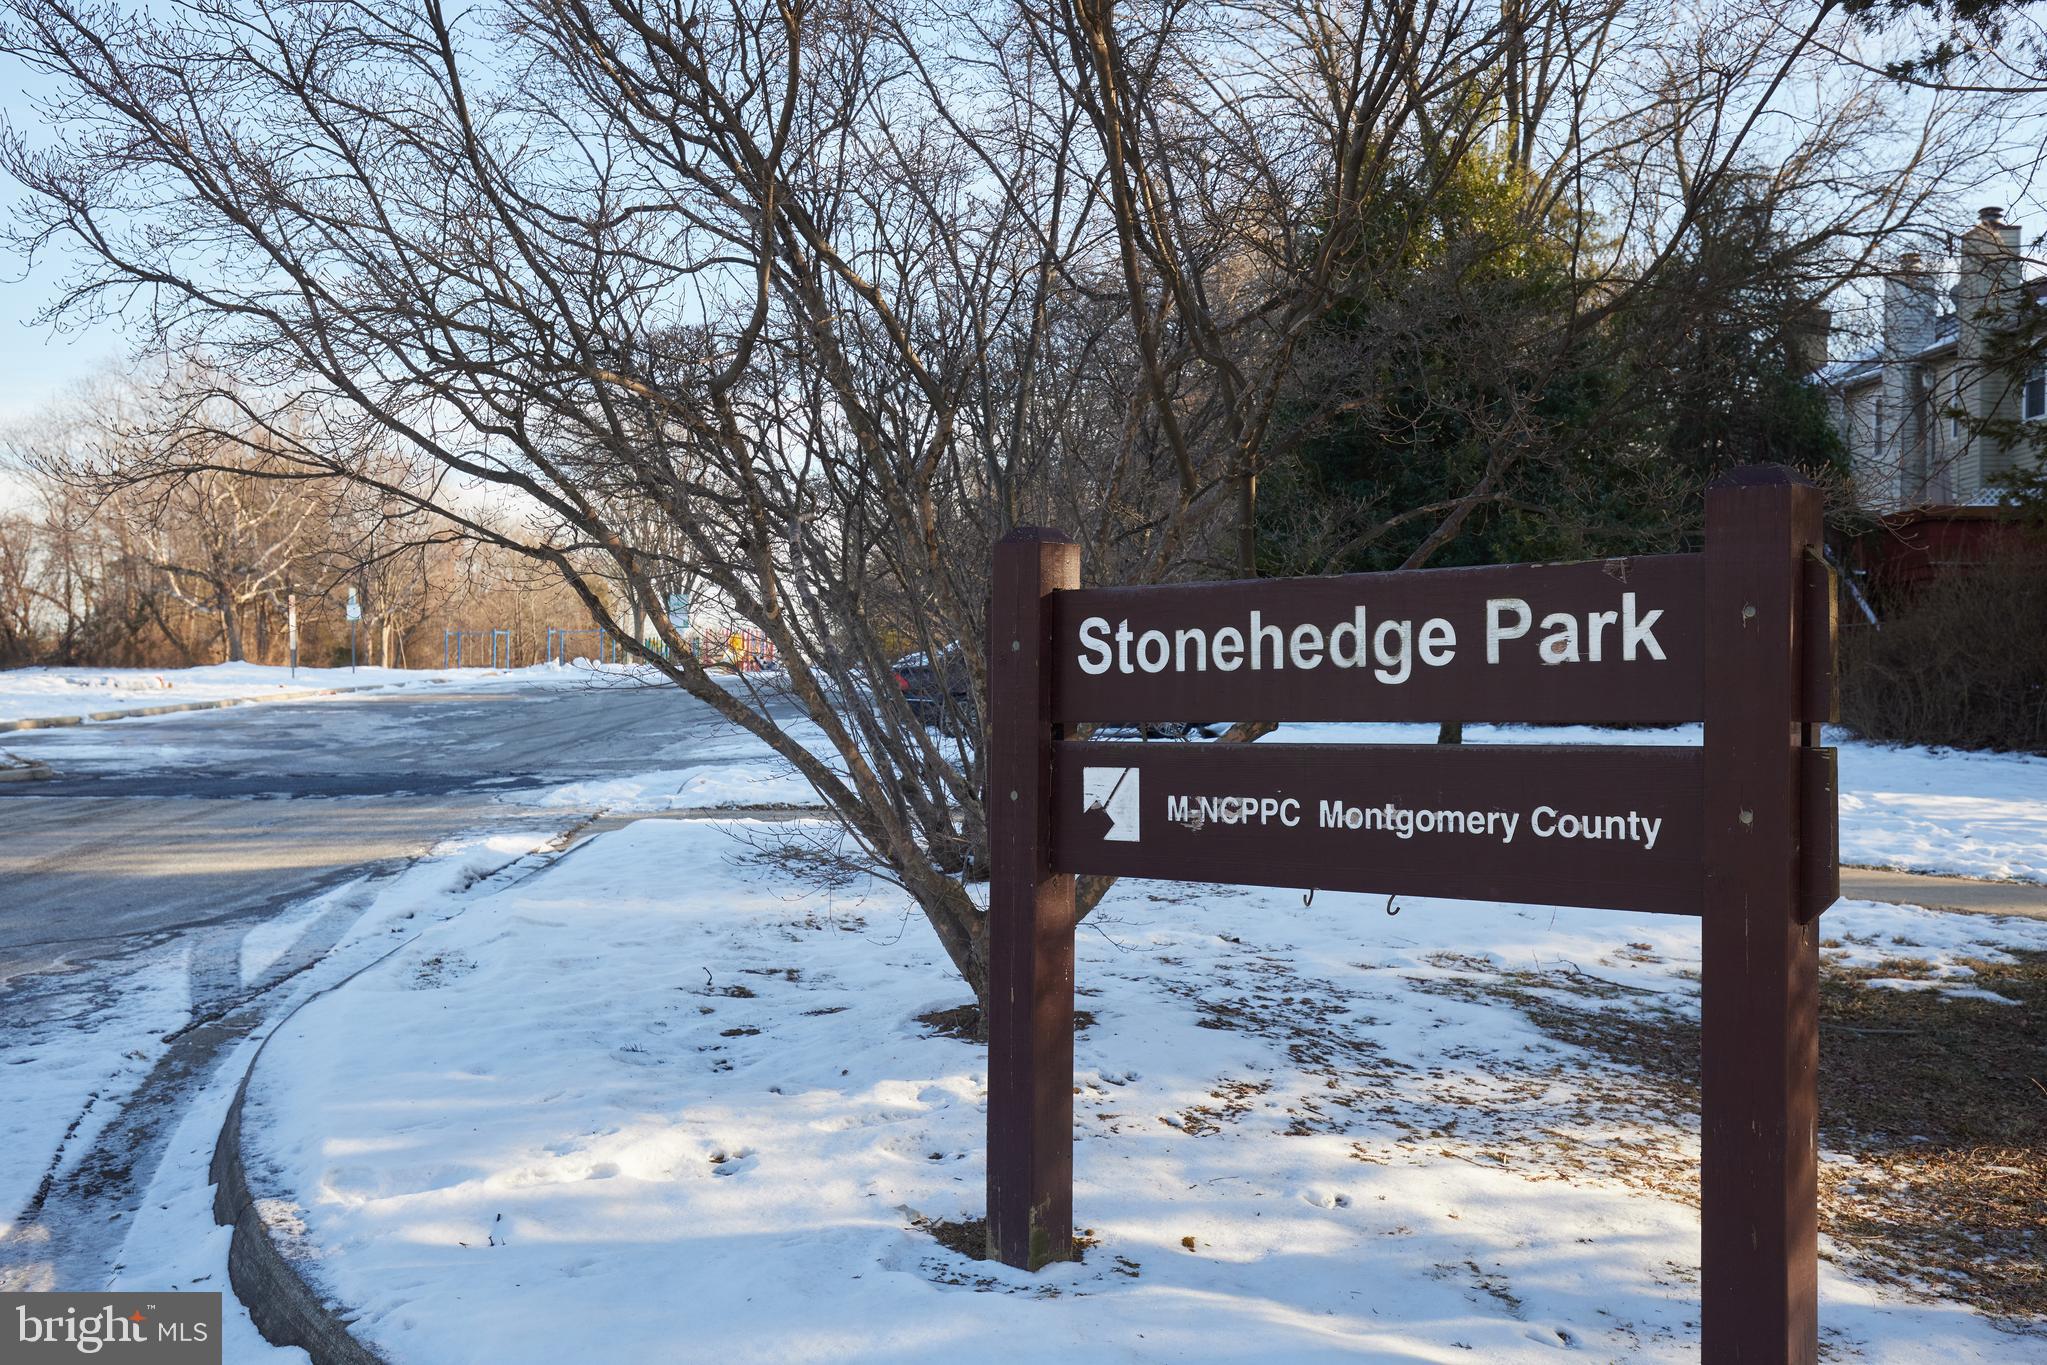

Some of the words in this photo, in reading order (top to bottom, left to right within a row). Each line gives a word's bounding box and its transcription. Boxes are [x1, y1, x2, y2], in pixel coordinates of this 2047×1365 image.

[1077, 605, 1457, 685] Stonehedge
[1485, 592, 1668, 665] Park
[1167, 795, 1301, 827] M-NCPPC
[1319, 800, 1520, 844] Montgomery
[1531, 805, 1662, 850] County
